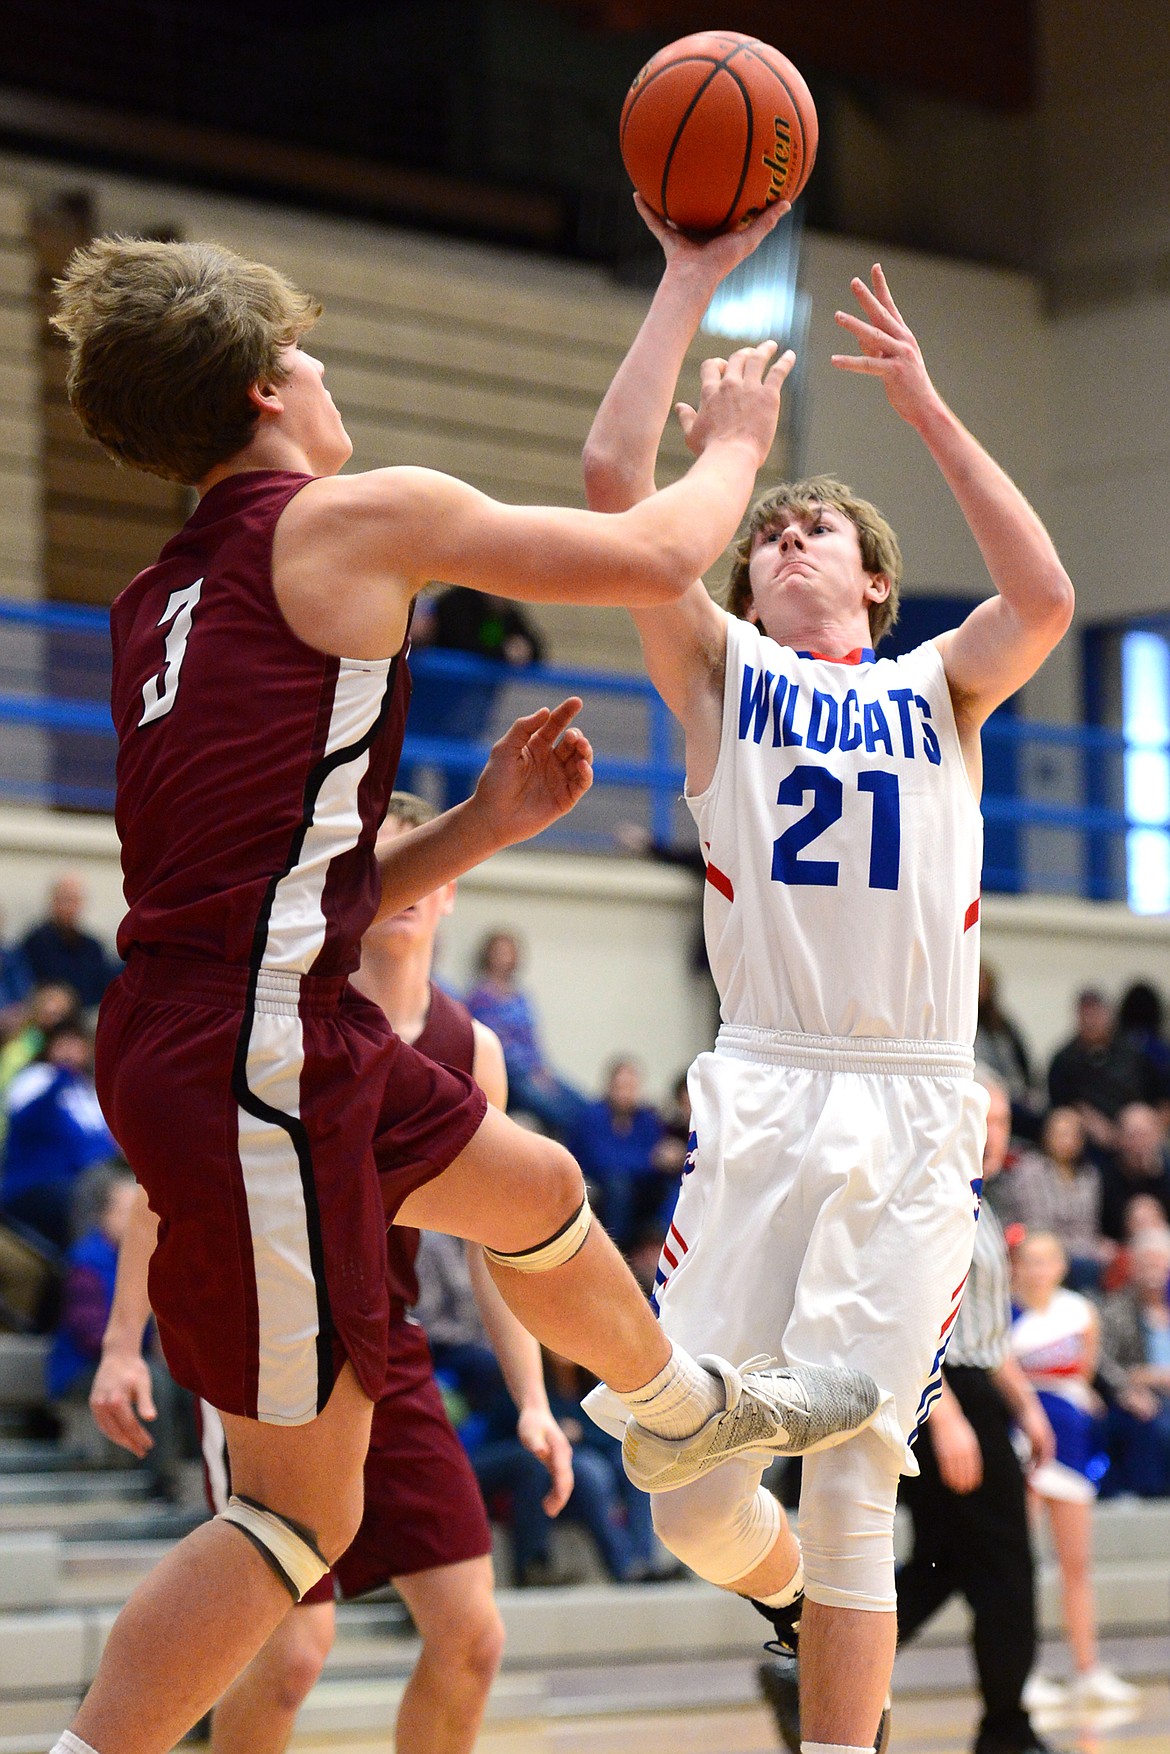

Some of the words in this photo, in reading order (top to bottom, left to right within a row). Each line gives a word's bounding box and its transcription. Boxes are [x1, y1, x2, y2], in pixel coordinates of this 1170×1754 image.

[138, 577, 205, 728] 3
[738, 663, 942, 767] WILDCATS
[771, 764, 901, 891] 21
